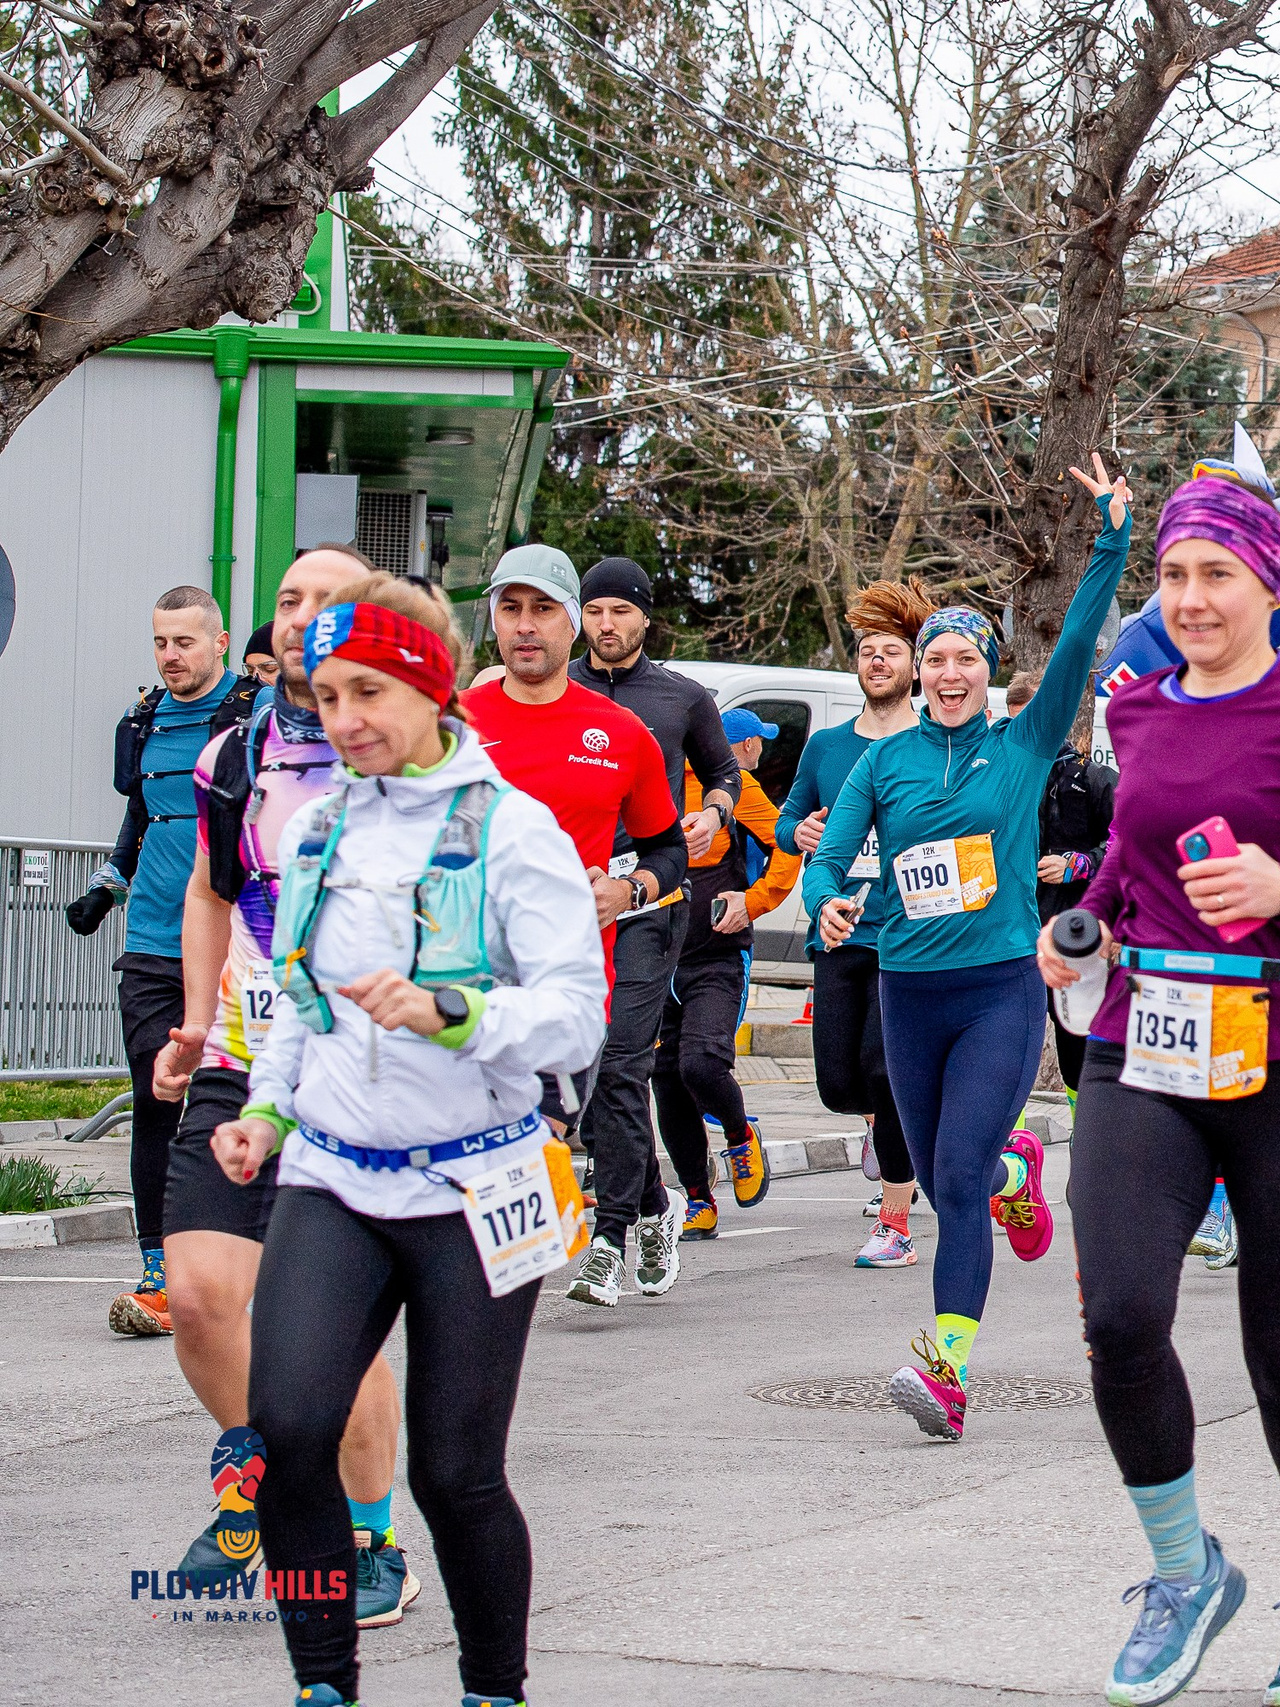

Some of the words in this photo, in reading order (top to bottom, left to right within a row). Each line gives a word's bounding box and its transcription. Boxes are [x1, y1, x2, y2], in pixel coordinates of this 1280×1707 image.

[568, 754, 602, 766] ProCredit
[602, 758, 619, 770] Bank
[617, 857, 630, 866] 12K
[922, 847, 936, 856] 12K
[902, 863, 949, 892] 1190
[246, 990, 282, 1020] 12
[1136, 1010, 1198, 1052] 1354
[482, 1191, 547, 1247] 1172
